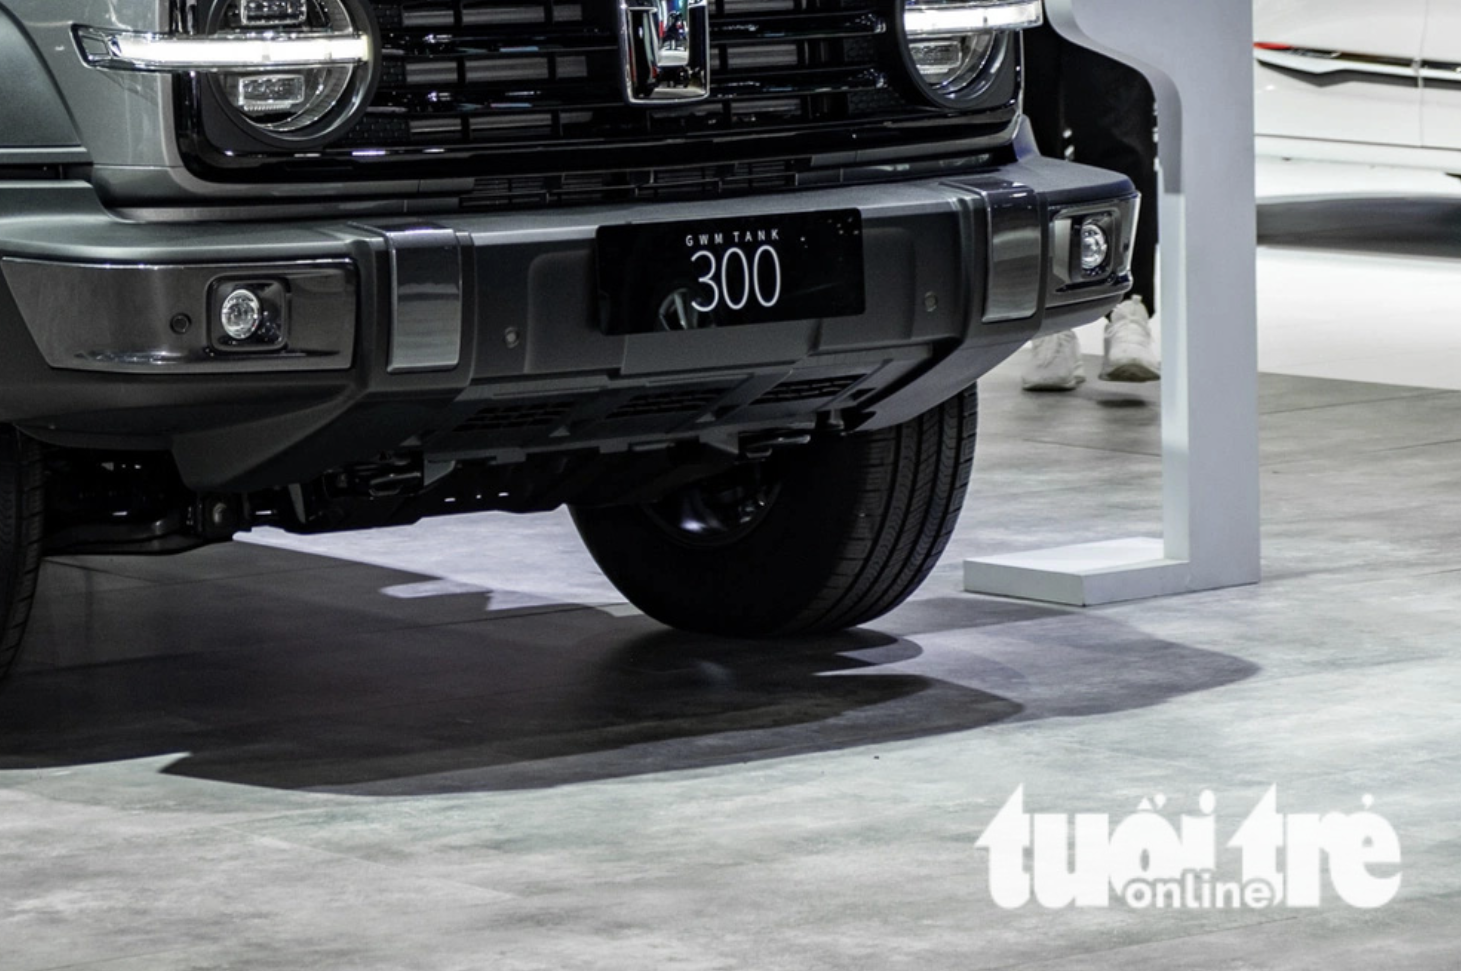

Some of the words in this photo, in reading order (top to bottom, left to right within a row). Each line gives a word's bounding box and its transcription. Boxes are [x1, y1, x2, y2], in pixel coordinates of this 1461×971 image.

[685, 233, 723, 247] GWM
[732, 228, 779, 243] TANK
[690, 244, 781, 312] 300
